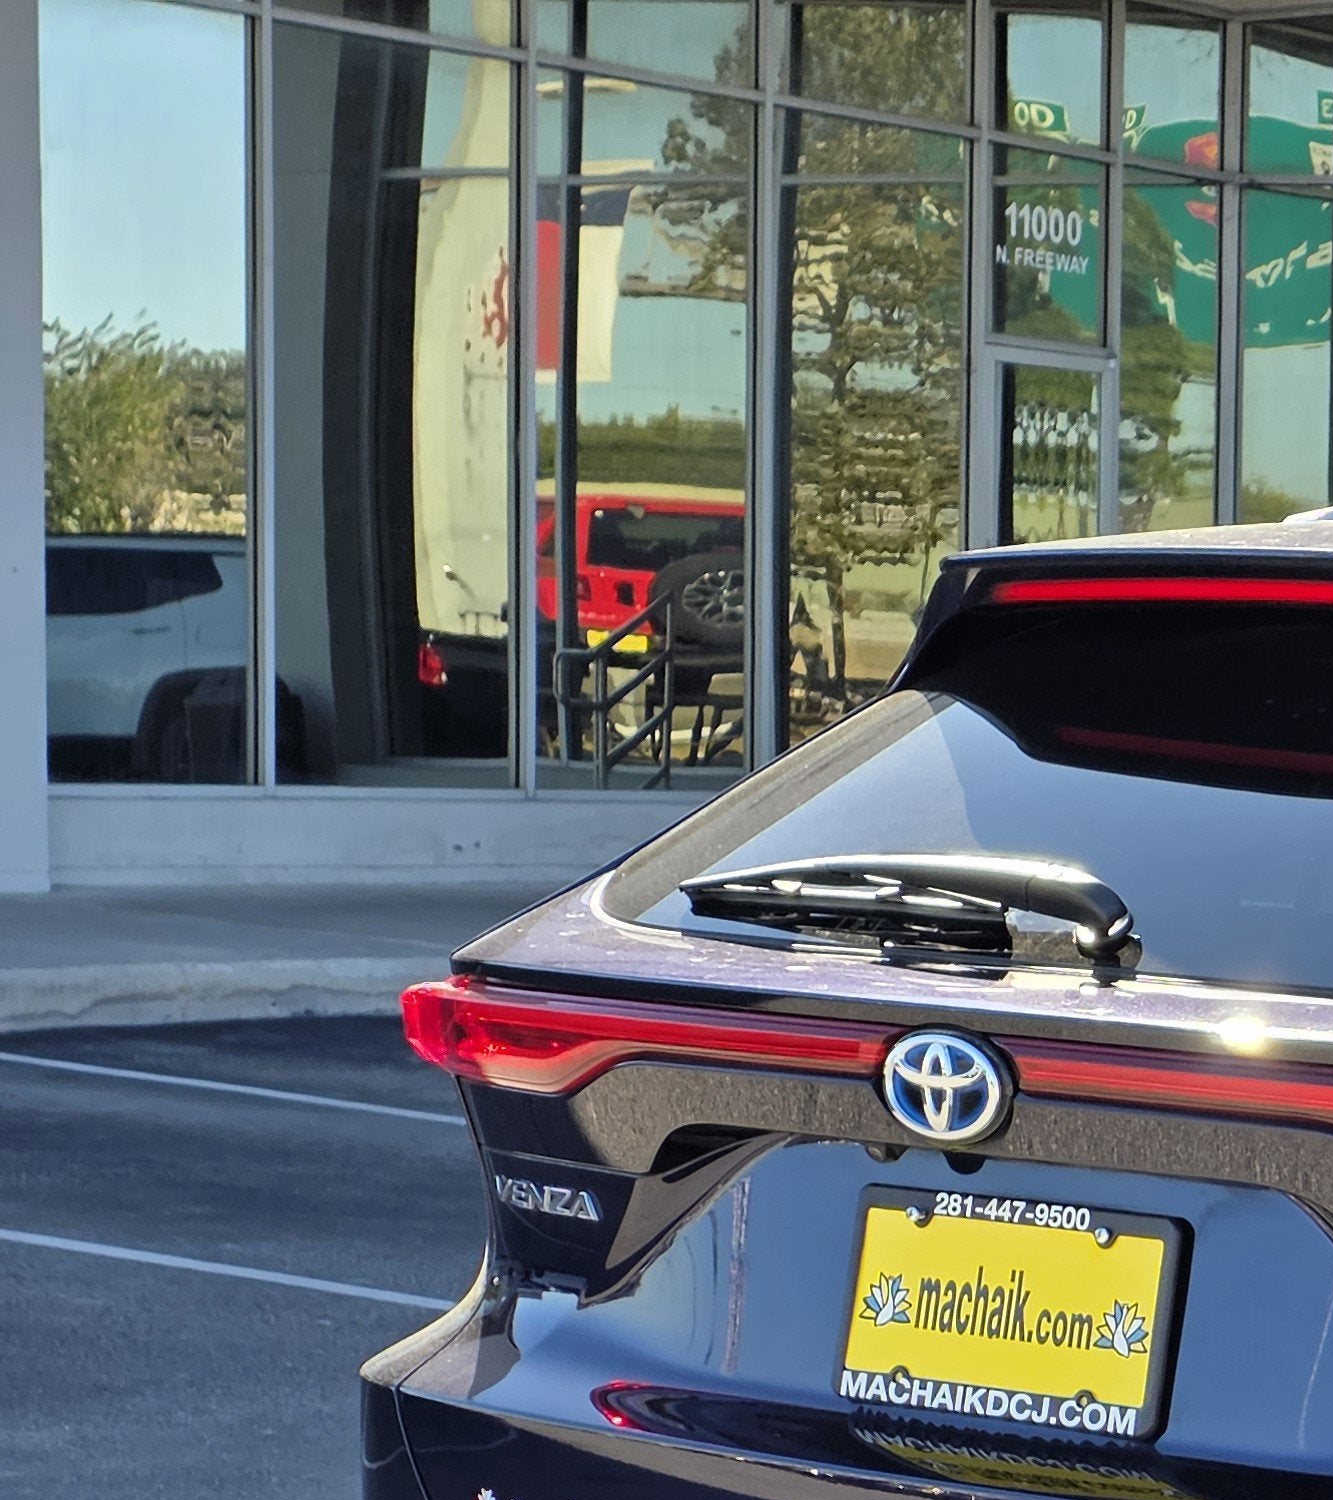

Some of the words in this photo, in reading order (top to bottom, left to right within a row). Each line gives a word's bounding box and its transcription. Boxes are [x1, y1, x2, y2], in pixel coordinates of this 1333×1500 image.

[1004, 201, 1083, 246] 11000
[995, 244, 1011, 264] N.
[1014, 247, 1090, 275] FREEWAY
[495, 1174, 602, 1221] VENZA
[933, 1192, 1091, 1231] 281-447-9500
[913, 1265, 1094, 1350] machaik.com
[839, 1369, 1137, 1436] MACHAIKDCJ.COM
